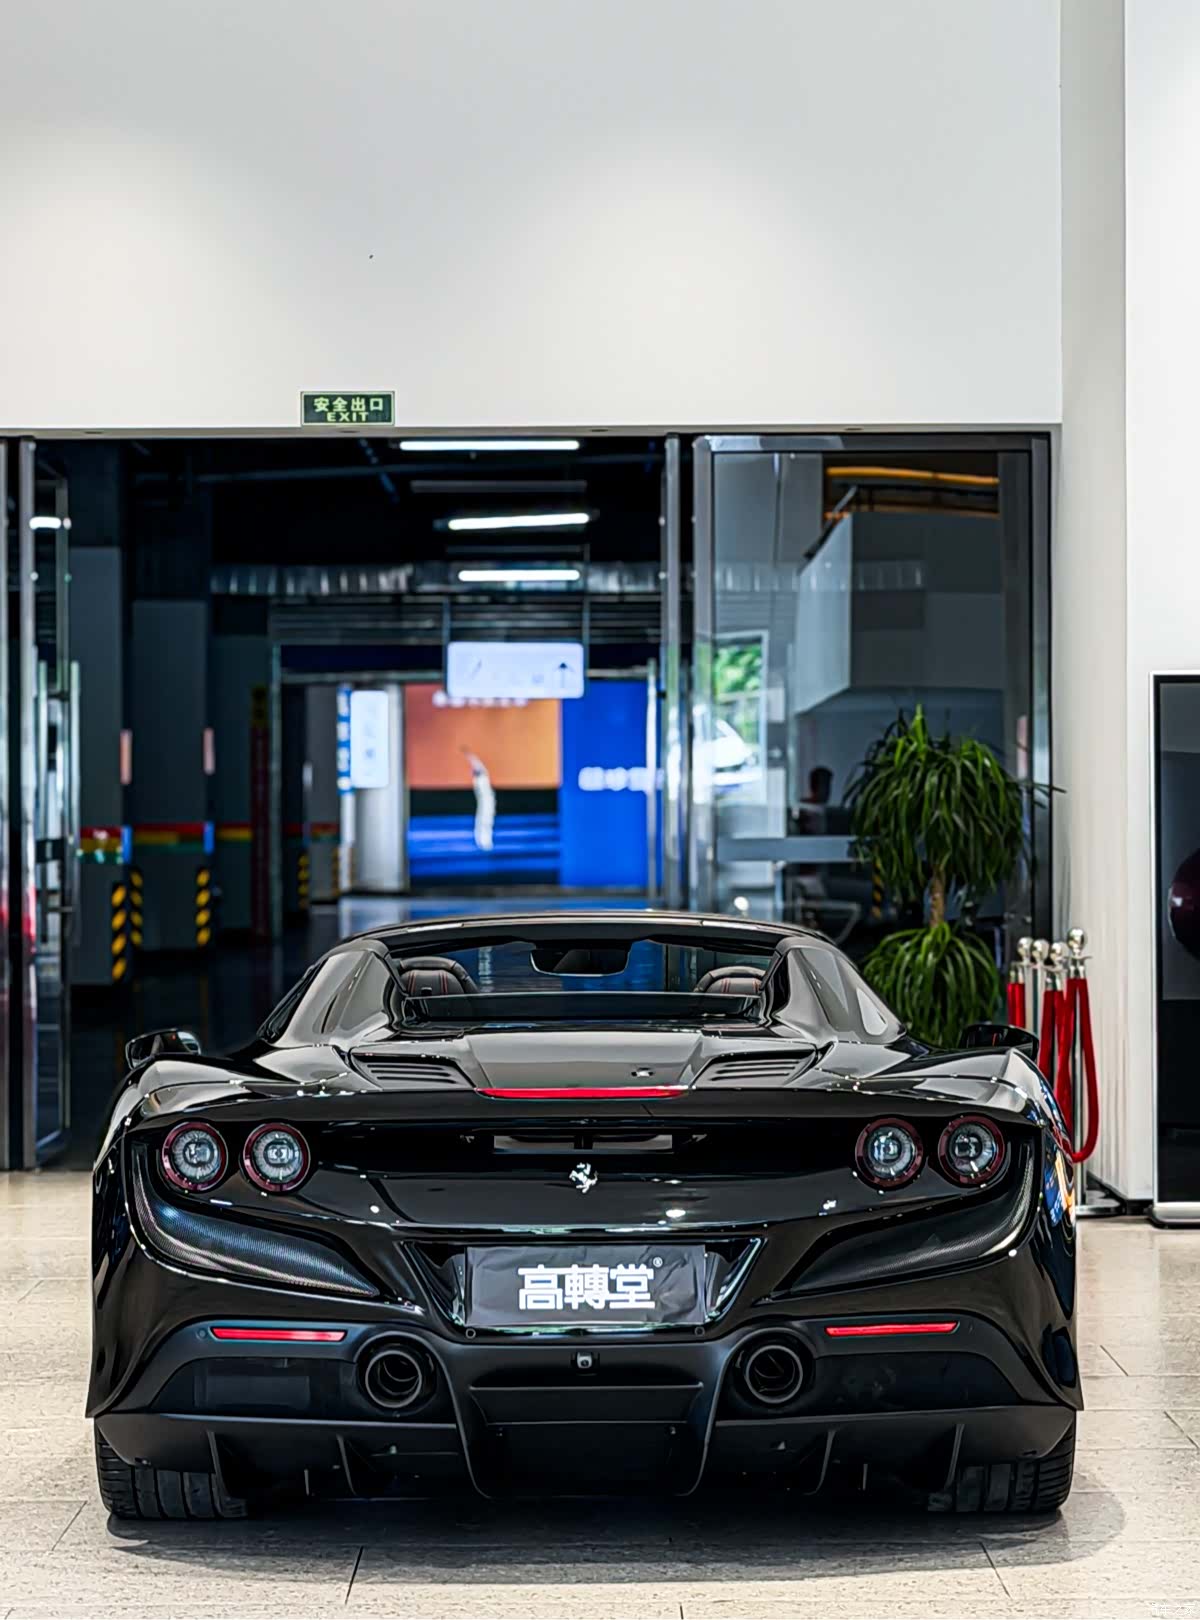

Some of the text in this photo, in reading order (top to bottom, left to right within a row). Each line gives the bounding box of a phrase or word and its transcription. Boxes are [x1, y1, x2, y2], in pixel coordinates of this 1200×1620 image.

[313, 397, 384, 413] 安全出口
[326, 412, 369, 422] EXIT
